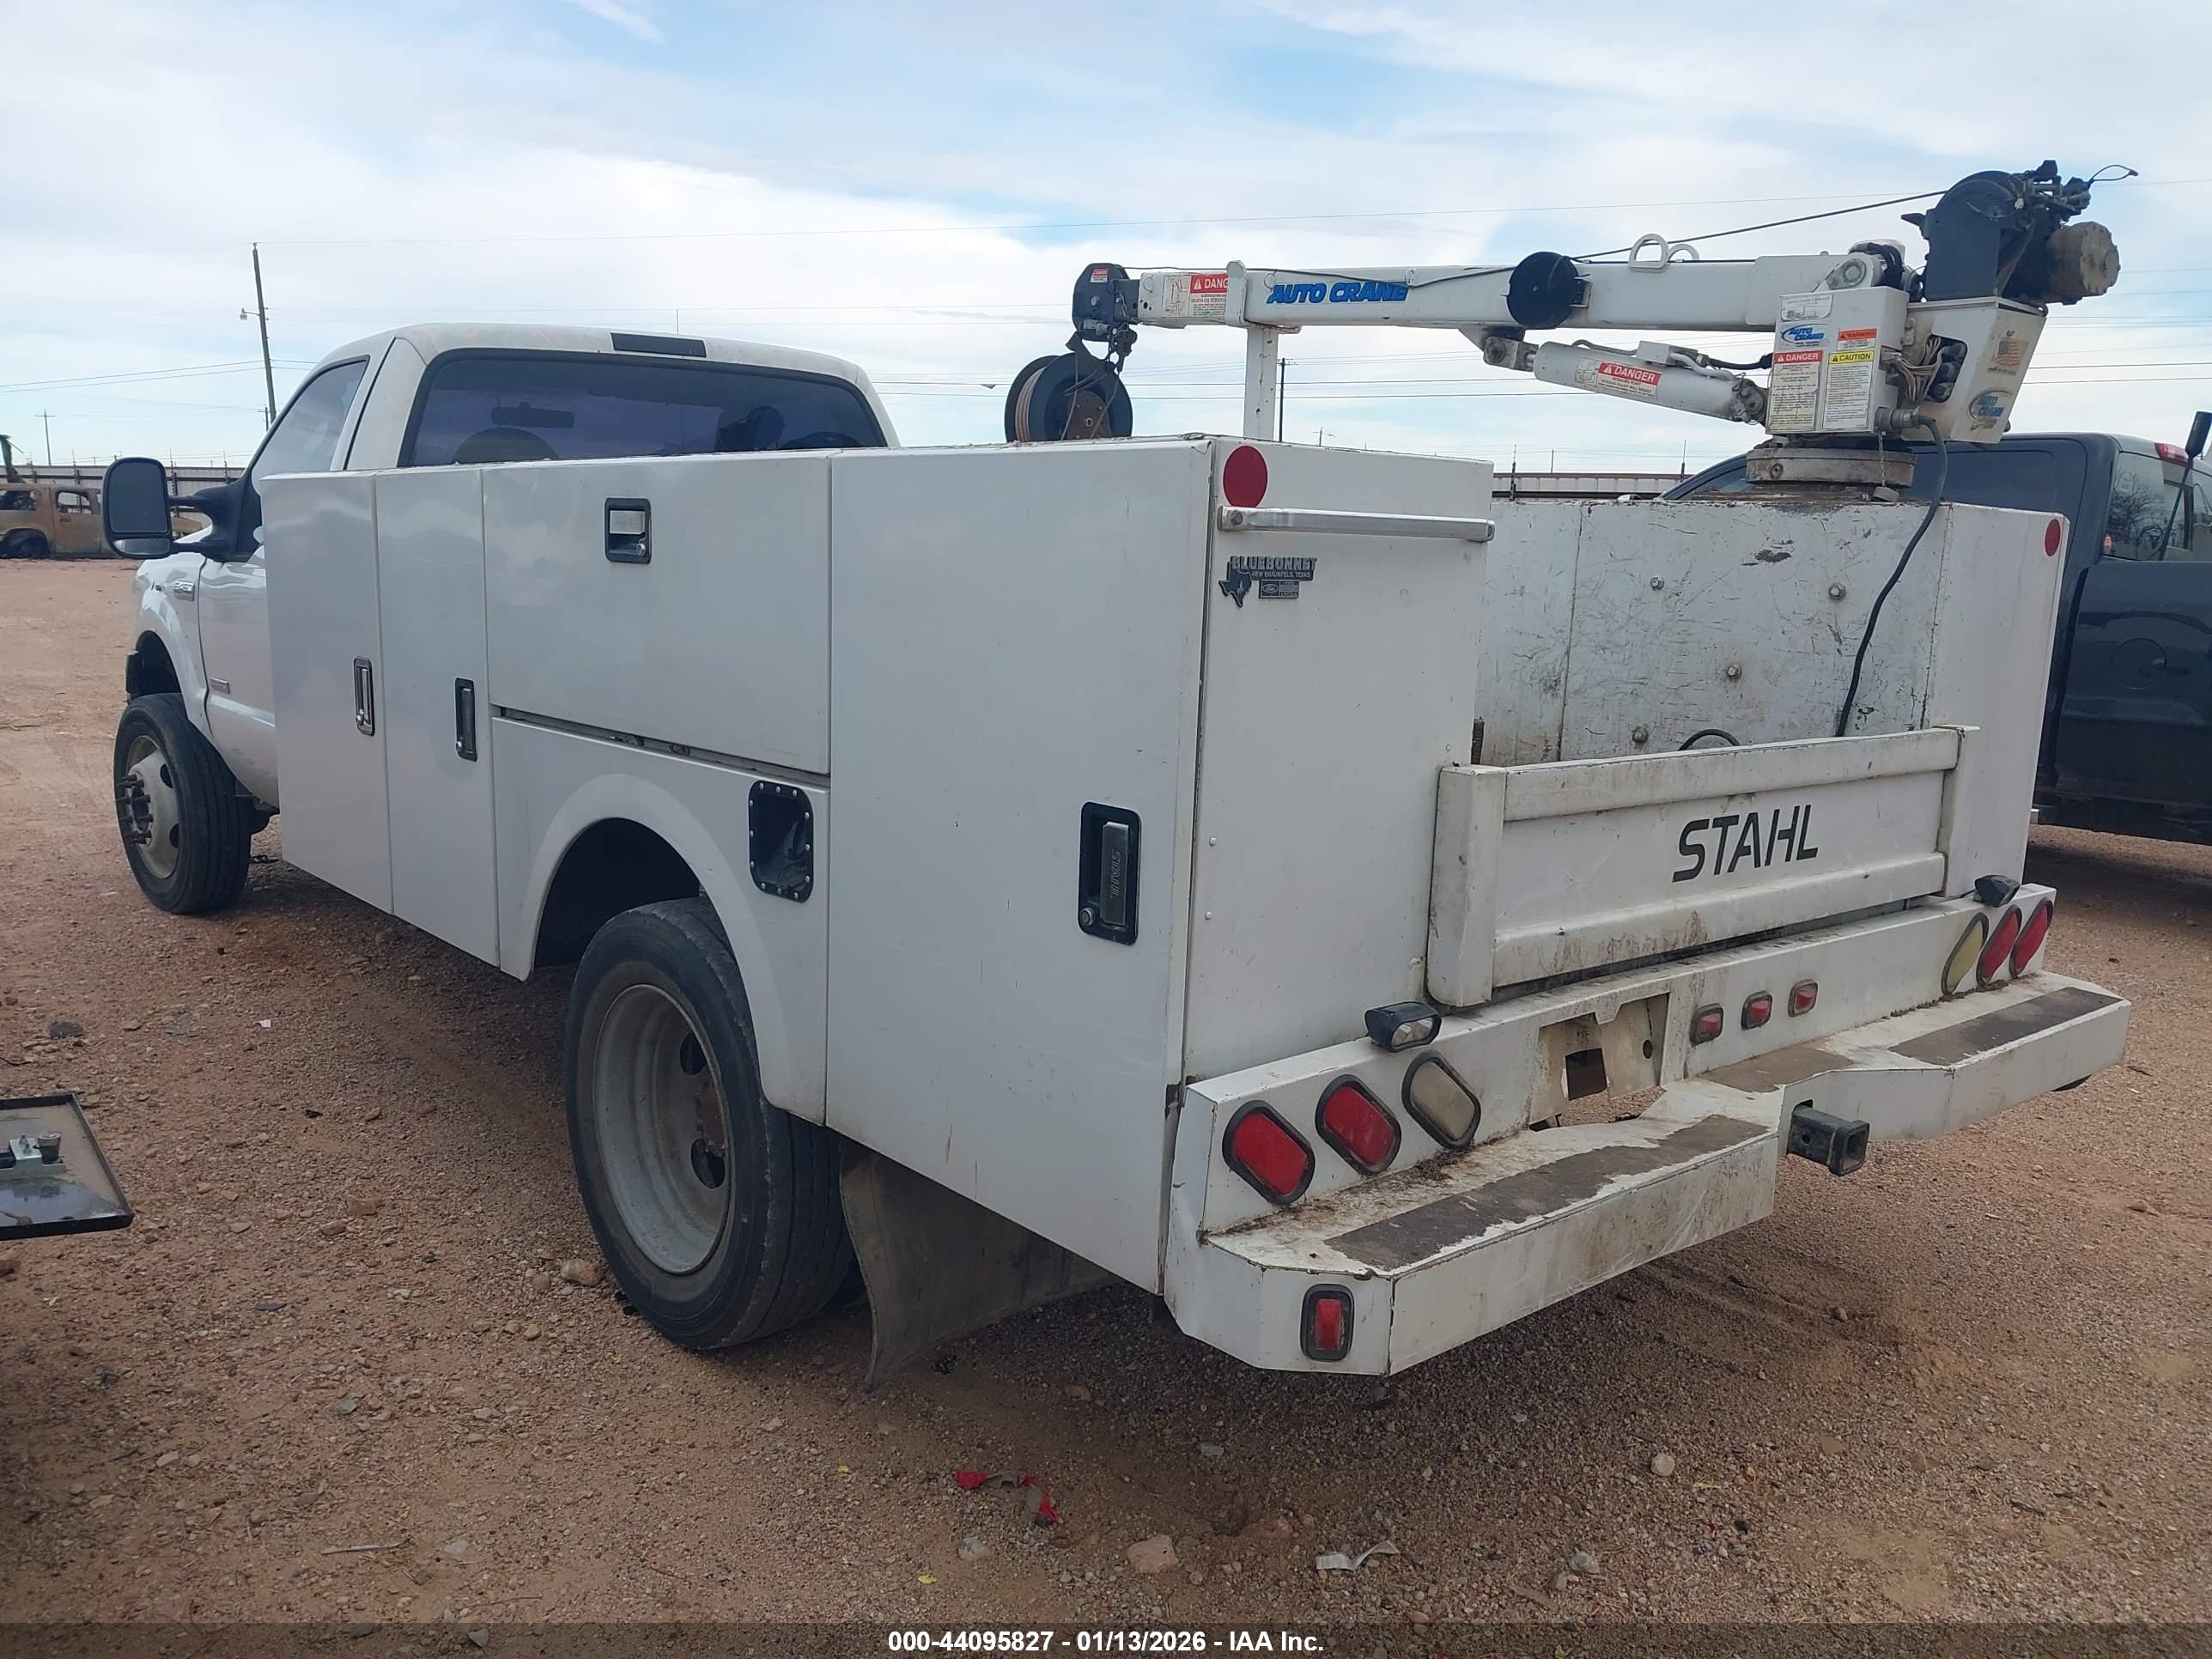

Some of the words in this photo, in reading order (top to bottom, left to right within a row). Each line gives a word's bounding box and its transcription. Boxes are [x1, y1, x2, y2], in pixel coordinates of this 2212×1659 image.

[1204, 277, 1229, 289] DANG
[1267, 283, 1327, 303] AUTO
[1331, 282, 1409, 302] CRANE
[1788, 326, 1814, 336] AUTO
[1786, 352, 1819, 362] DANGER
[1839, 353, 1871, 362] CAUTION
[1614, 366, 1656, 383] DANGER
[1231, 556, 1317, 571] BLUEBONNET
[1672, 805, 1819, 883] STAHL
